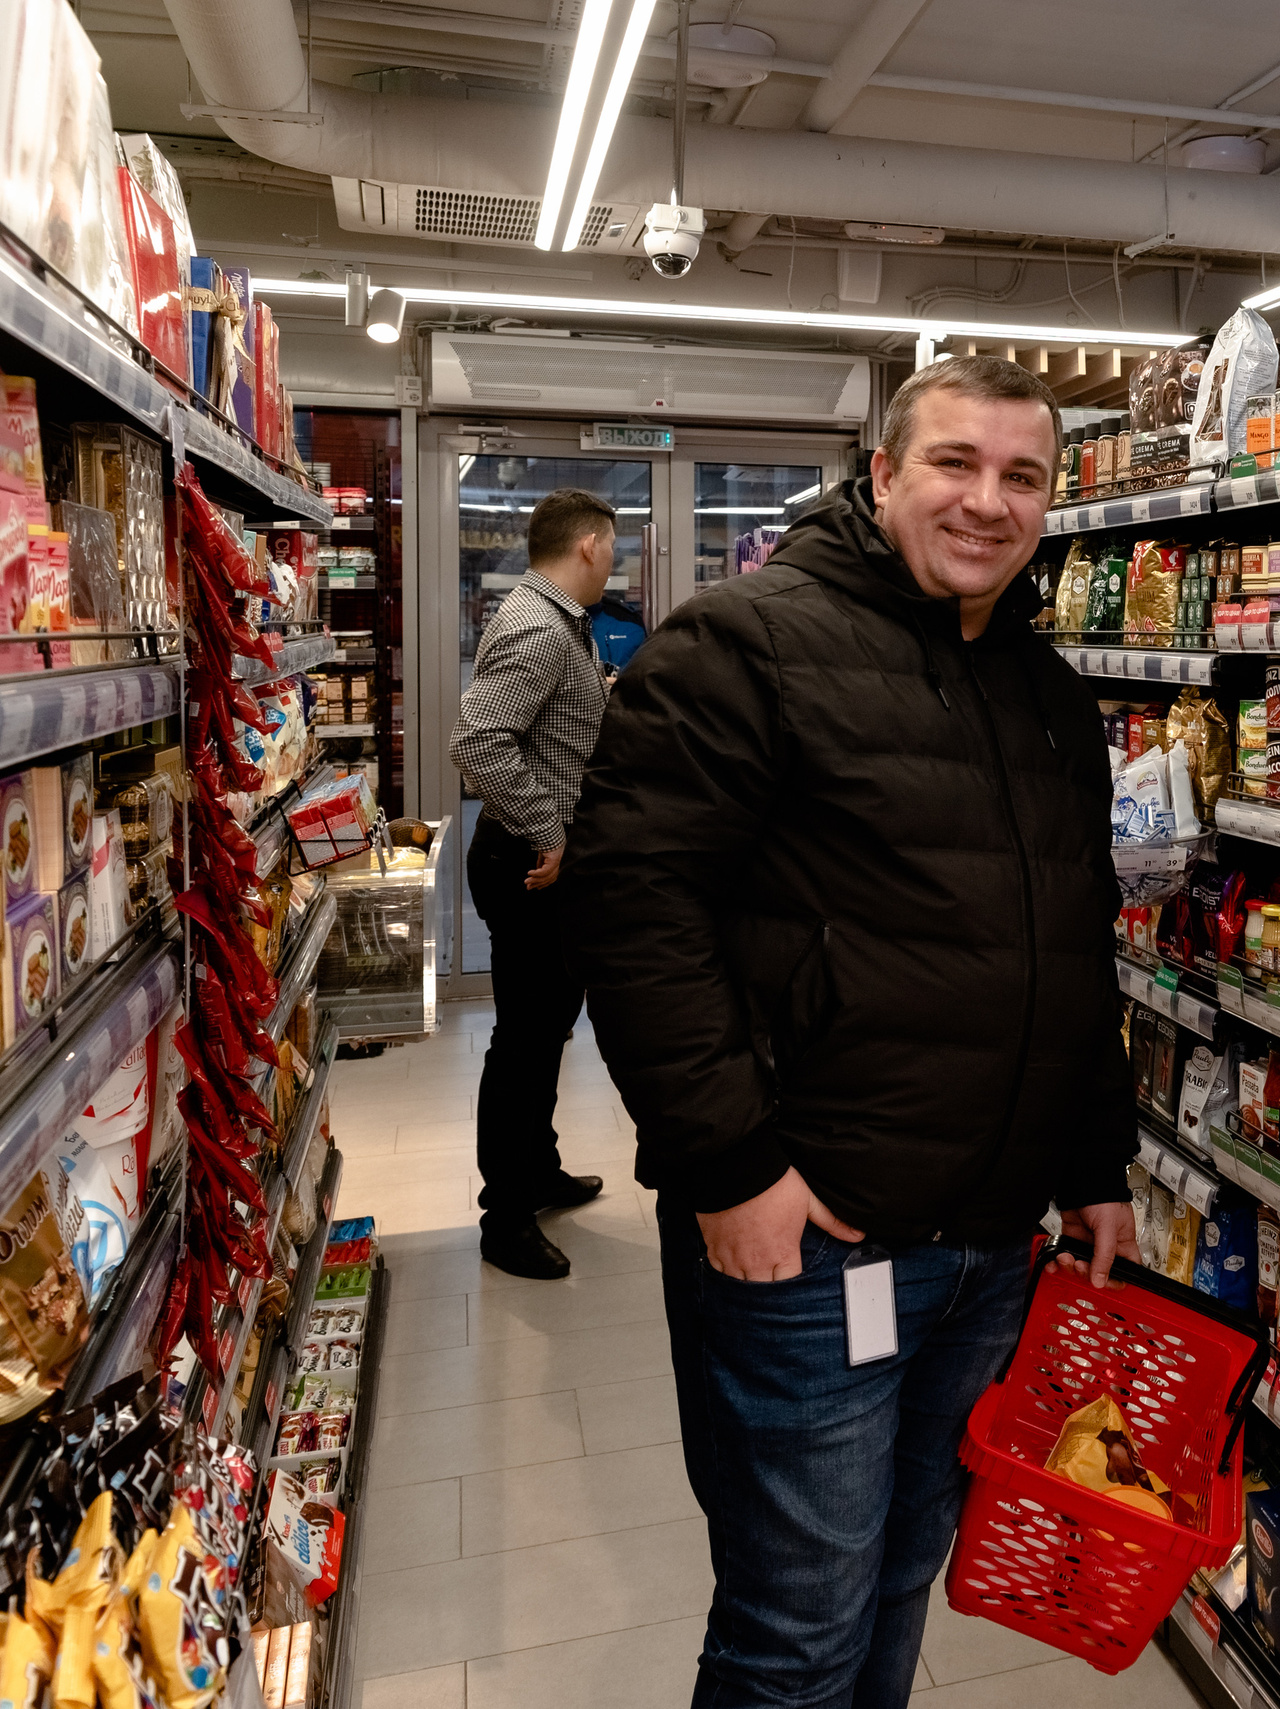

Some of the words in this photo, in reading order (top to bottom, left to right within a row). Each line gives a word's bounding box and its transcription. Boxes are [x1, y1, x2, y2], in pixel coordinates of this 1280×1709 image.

[600, 430, 665, 446] ВЫХОД
[1241, 1076, 1259, 1093] Passata
[1261, 1227, 1277, 1240] HEINZ
[290, 1518, 310, 1565] délice
[1255, 1525, 1272, 1553] Barilla
